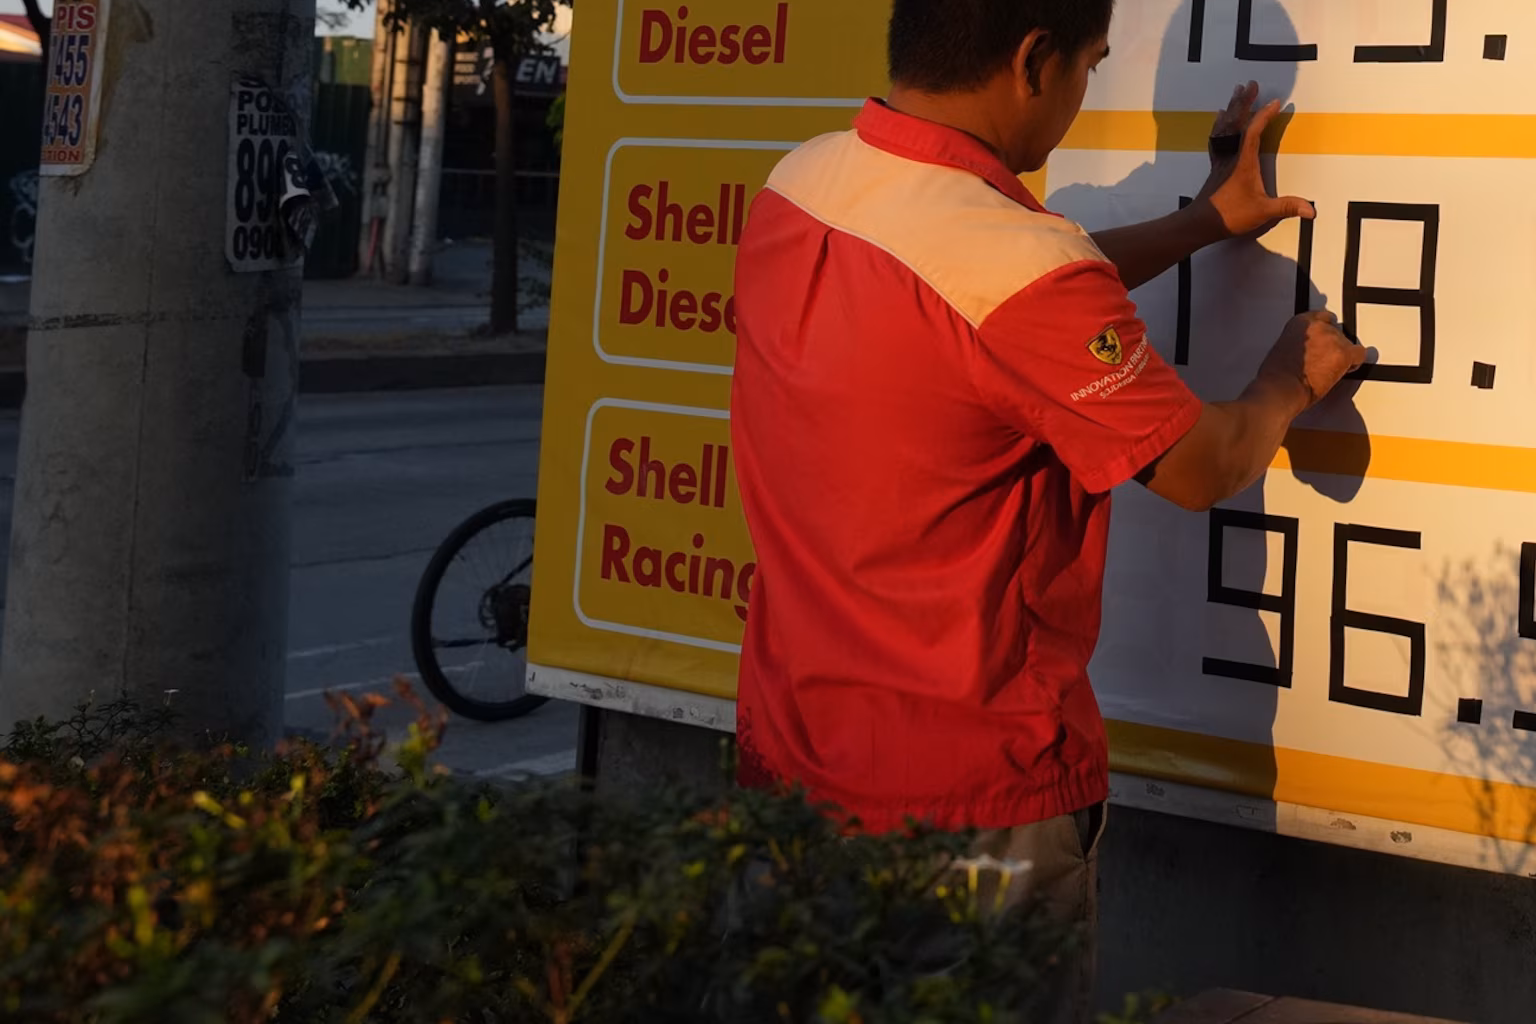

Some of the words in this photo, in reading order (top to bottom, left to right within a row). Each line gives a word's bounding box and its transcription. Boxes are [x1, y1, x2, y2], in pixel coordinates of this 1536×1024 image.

[638, 2, 788, 65] Diesel
[624, 181, 745, 245] Shell
[1070, 361, 1134, 402] INNOVATION
[605, 436, 728, 508] Shell
